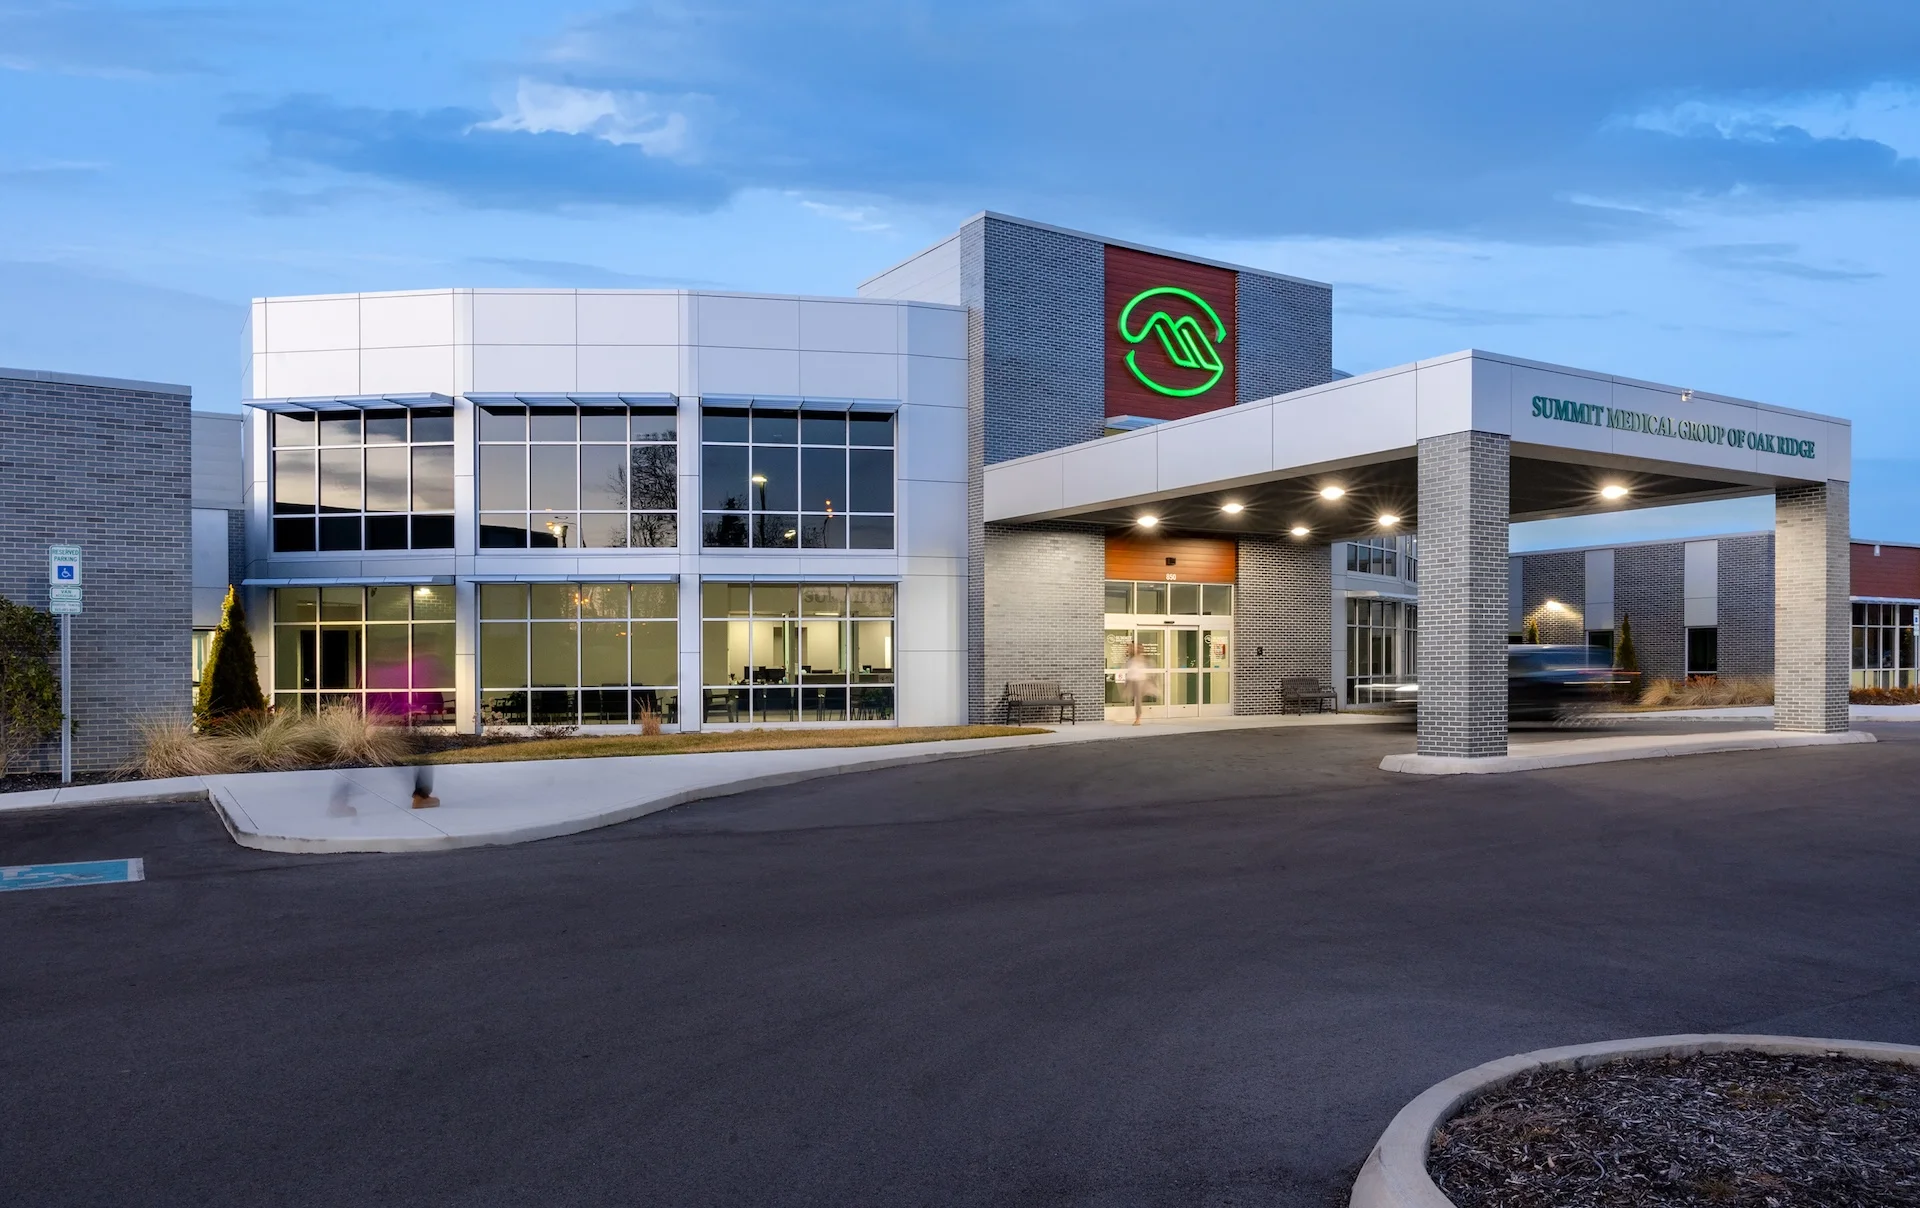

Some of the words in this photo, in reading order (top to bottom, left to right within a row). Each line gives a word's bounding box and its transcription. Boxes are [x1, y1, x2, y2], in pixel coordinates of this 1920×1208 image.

[1531, 395, 1605, 427] SUMMIT
[1606, 407, 1678, 439] MEDICAL
[1678, 418, 1726, 446] GROUP
[1727, 427, 1747, 449] OF
[1747, 430, 1777, 454] OAK
[1777, 435, 1817, 460] RIDGE
[1165, 573, 1177, 581] 850
